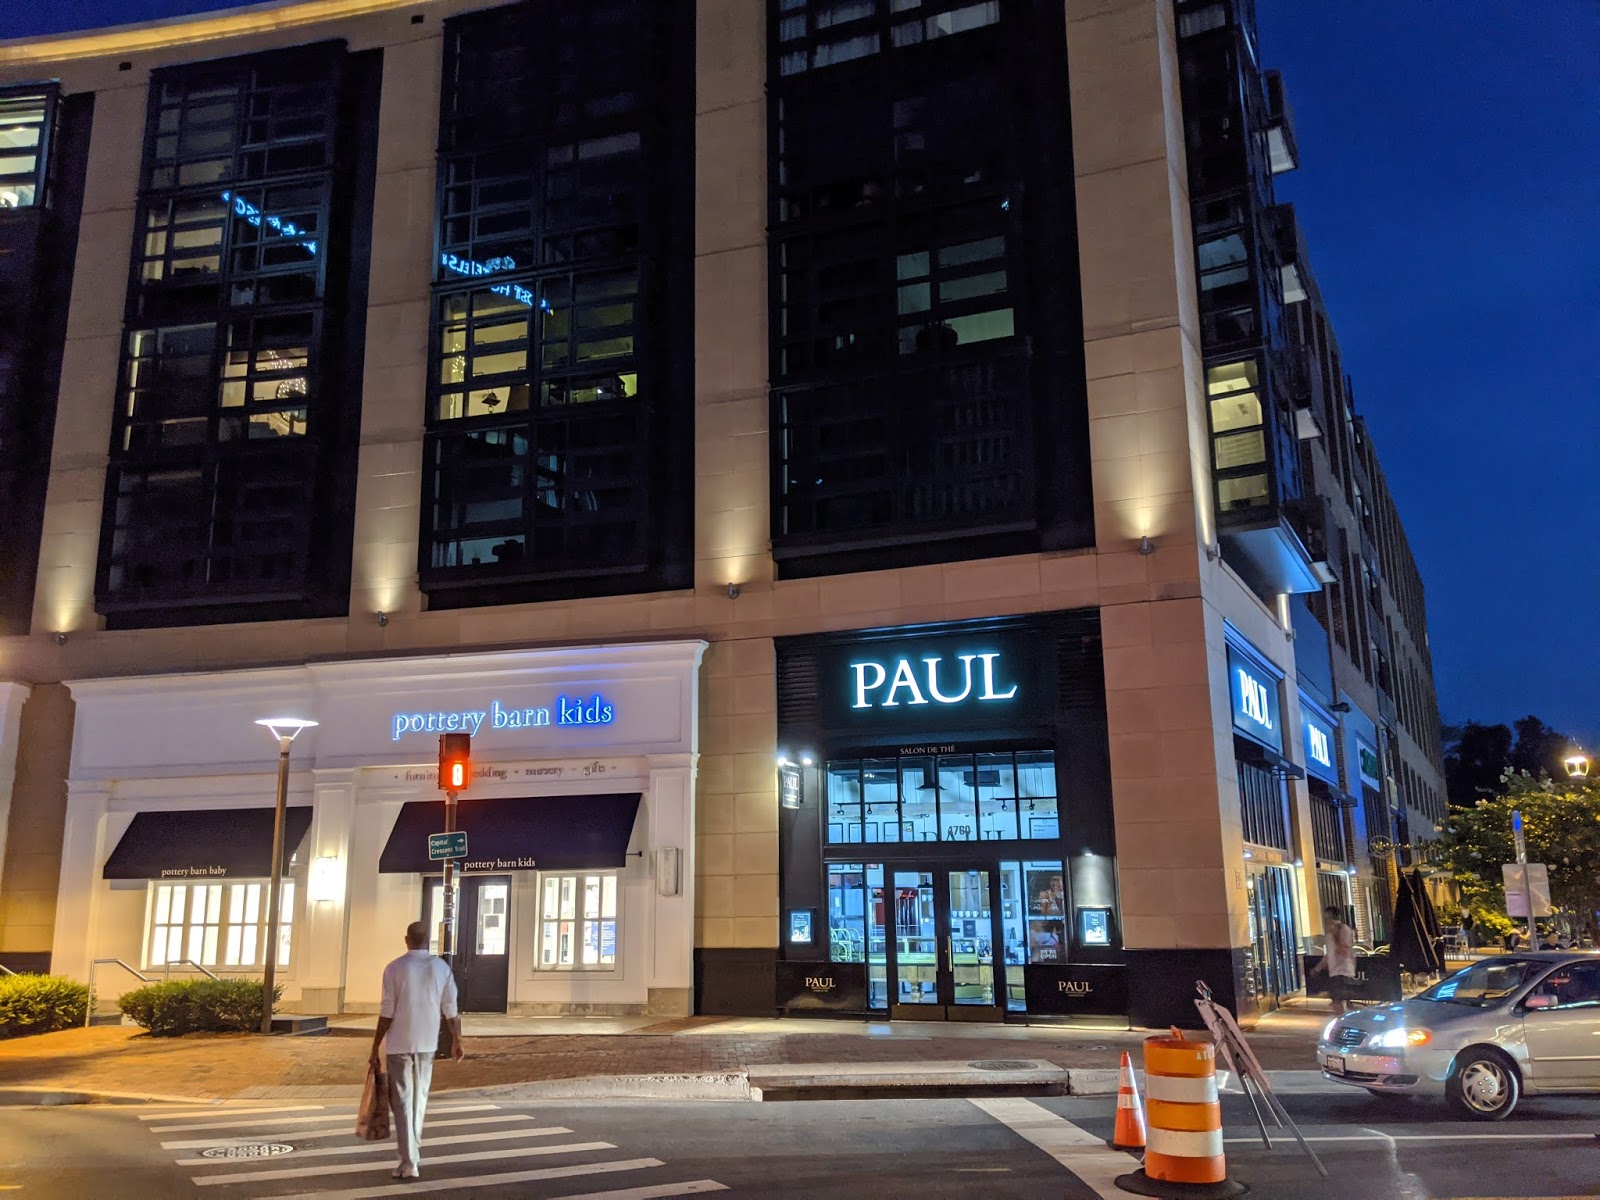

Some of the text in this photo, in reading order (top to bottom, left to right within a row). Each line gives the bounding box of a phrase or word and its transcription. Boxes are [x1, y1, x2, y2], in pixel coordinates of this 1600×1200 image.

[850, 653, 1018, 708] PAUL
[1238, 669, 1273, 730] PAUL
[392, 696, 613, 740] pottery barn kids
[900, 747, 926, 755] SALON
[927, 746, 939, 754] DE
[1308, 724, 1331, 768] PAUL
[406, 761, 606, 781] furnit edding nursery gifts
[783, 775, 799, 791] PAUL
[431, 839, 448, 847] Capital
[431, 847, 454, 855] Crescent
[161, 865, 227, 877] pottery barn baby
[464, 857, 536, 871] pottery barn kids
[804, 977, 837, 988] PAUL
[1057, 980, 1094, 992] PAUL
